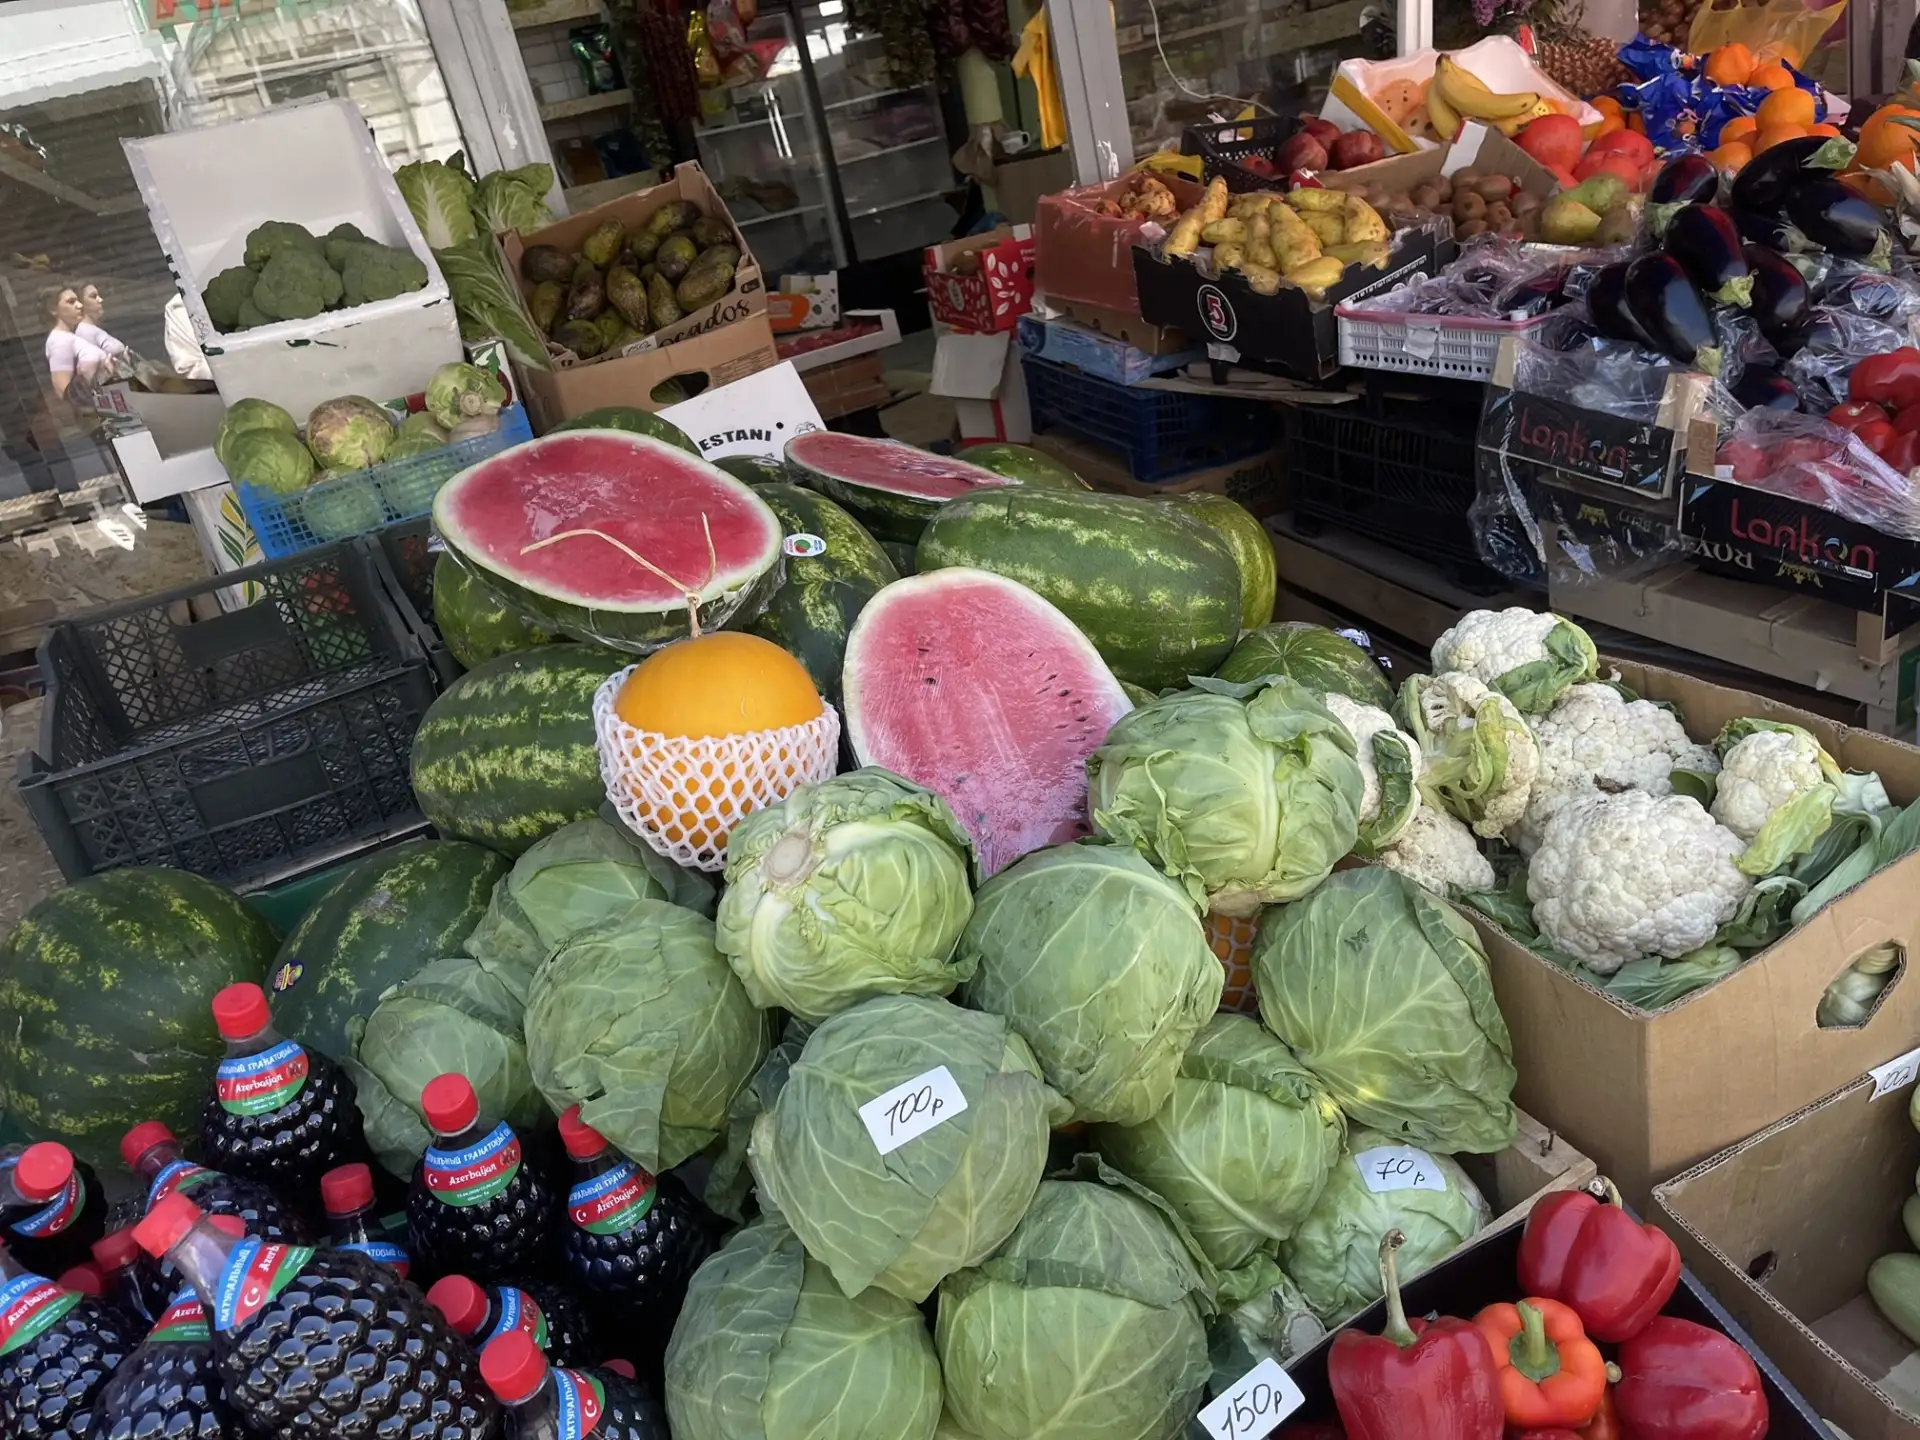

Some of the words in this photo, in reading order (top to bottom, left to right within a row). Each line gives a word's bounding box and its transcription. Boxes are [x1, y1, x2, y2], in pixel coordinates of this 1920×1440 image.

[1207, 294, 1225, 325] 5
[1730, 498, 1876, 571] Lankon
[235, 1073, 284, 1094] Azerbaijan
[448, 1162, 497, 1186] Azerbaijan
[596, 1184, 639, 1214] Azerbaijan
